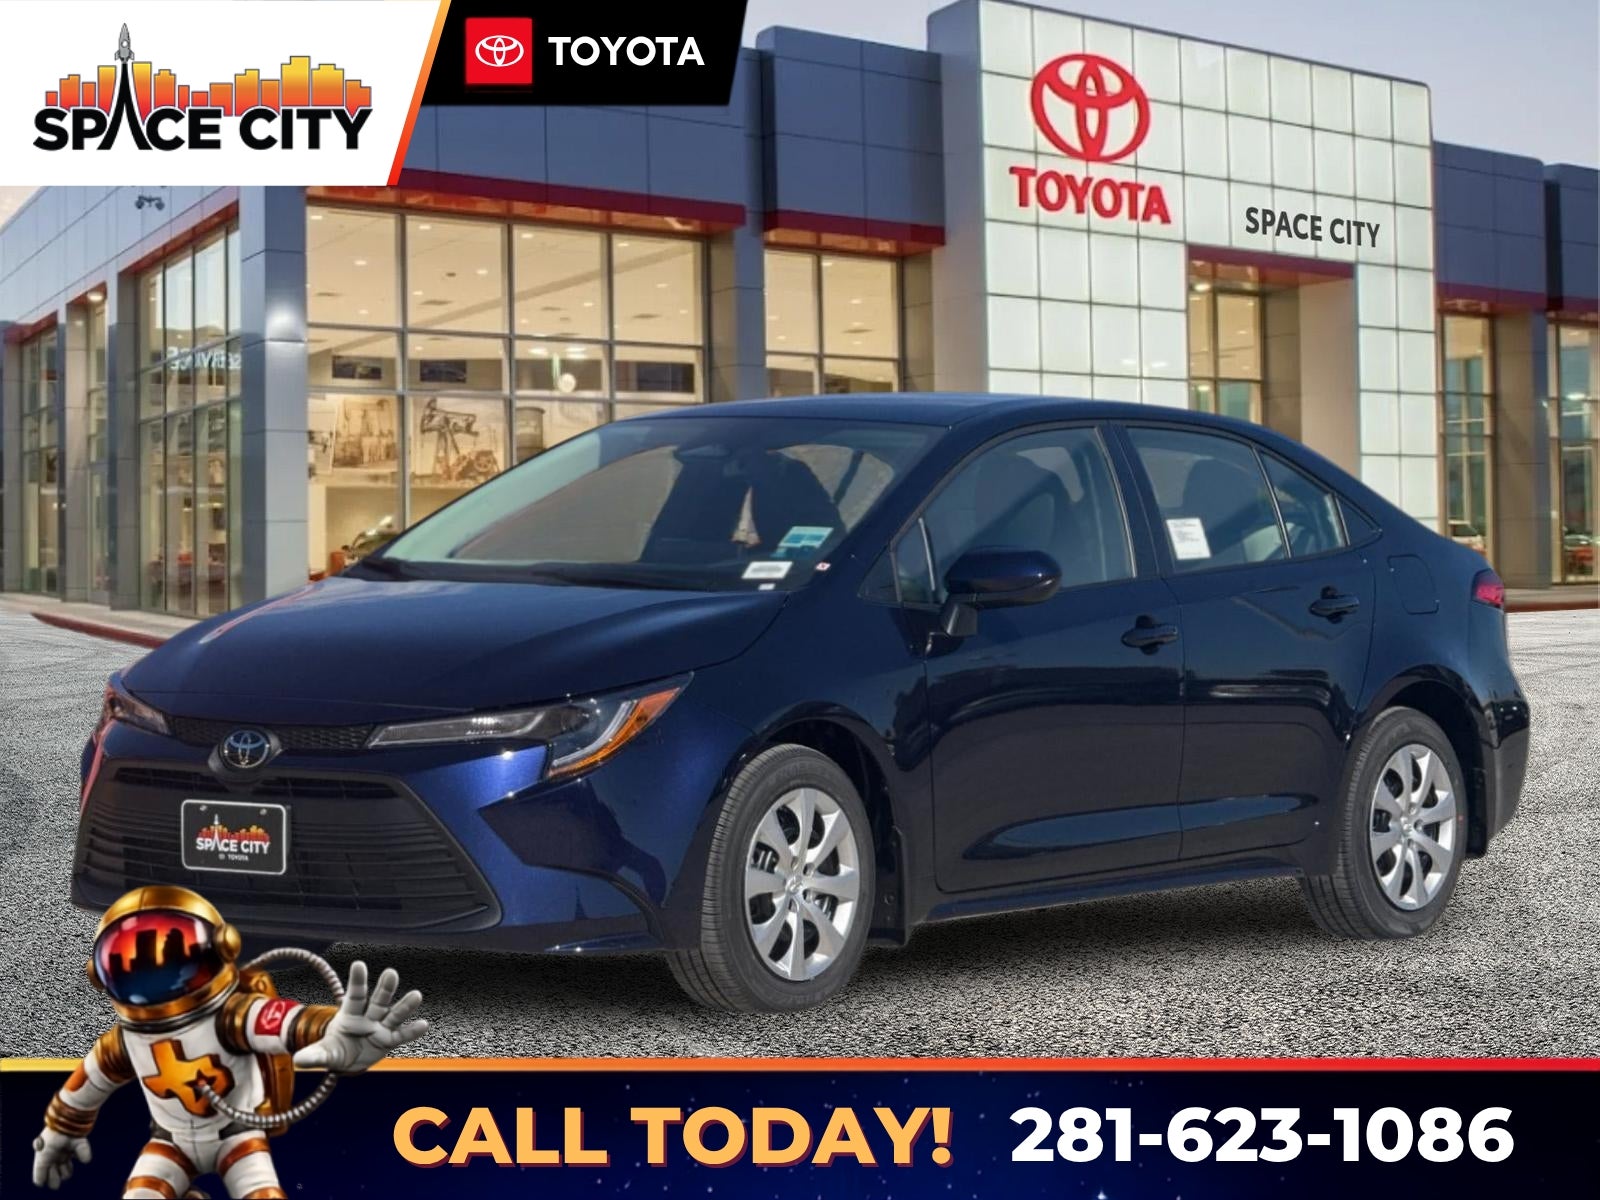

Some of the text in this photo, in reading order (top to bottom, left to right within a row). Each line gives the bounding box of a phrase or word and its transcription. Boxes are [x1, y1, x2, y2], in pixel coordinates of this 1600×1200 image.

[1009, 166, 1171, 224] TOYOTA
[1245, 206, 1380, 248] SPACE CITY
[196, 830, 270, 854] SPACE CITY
